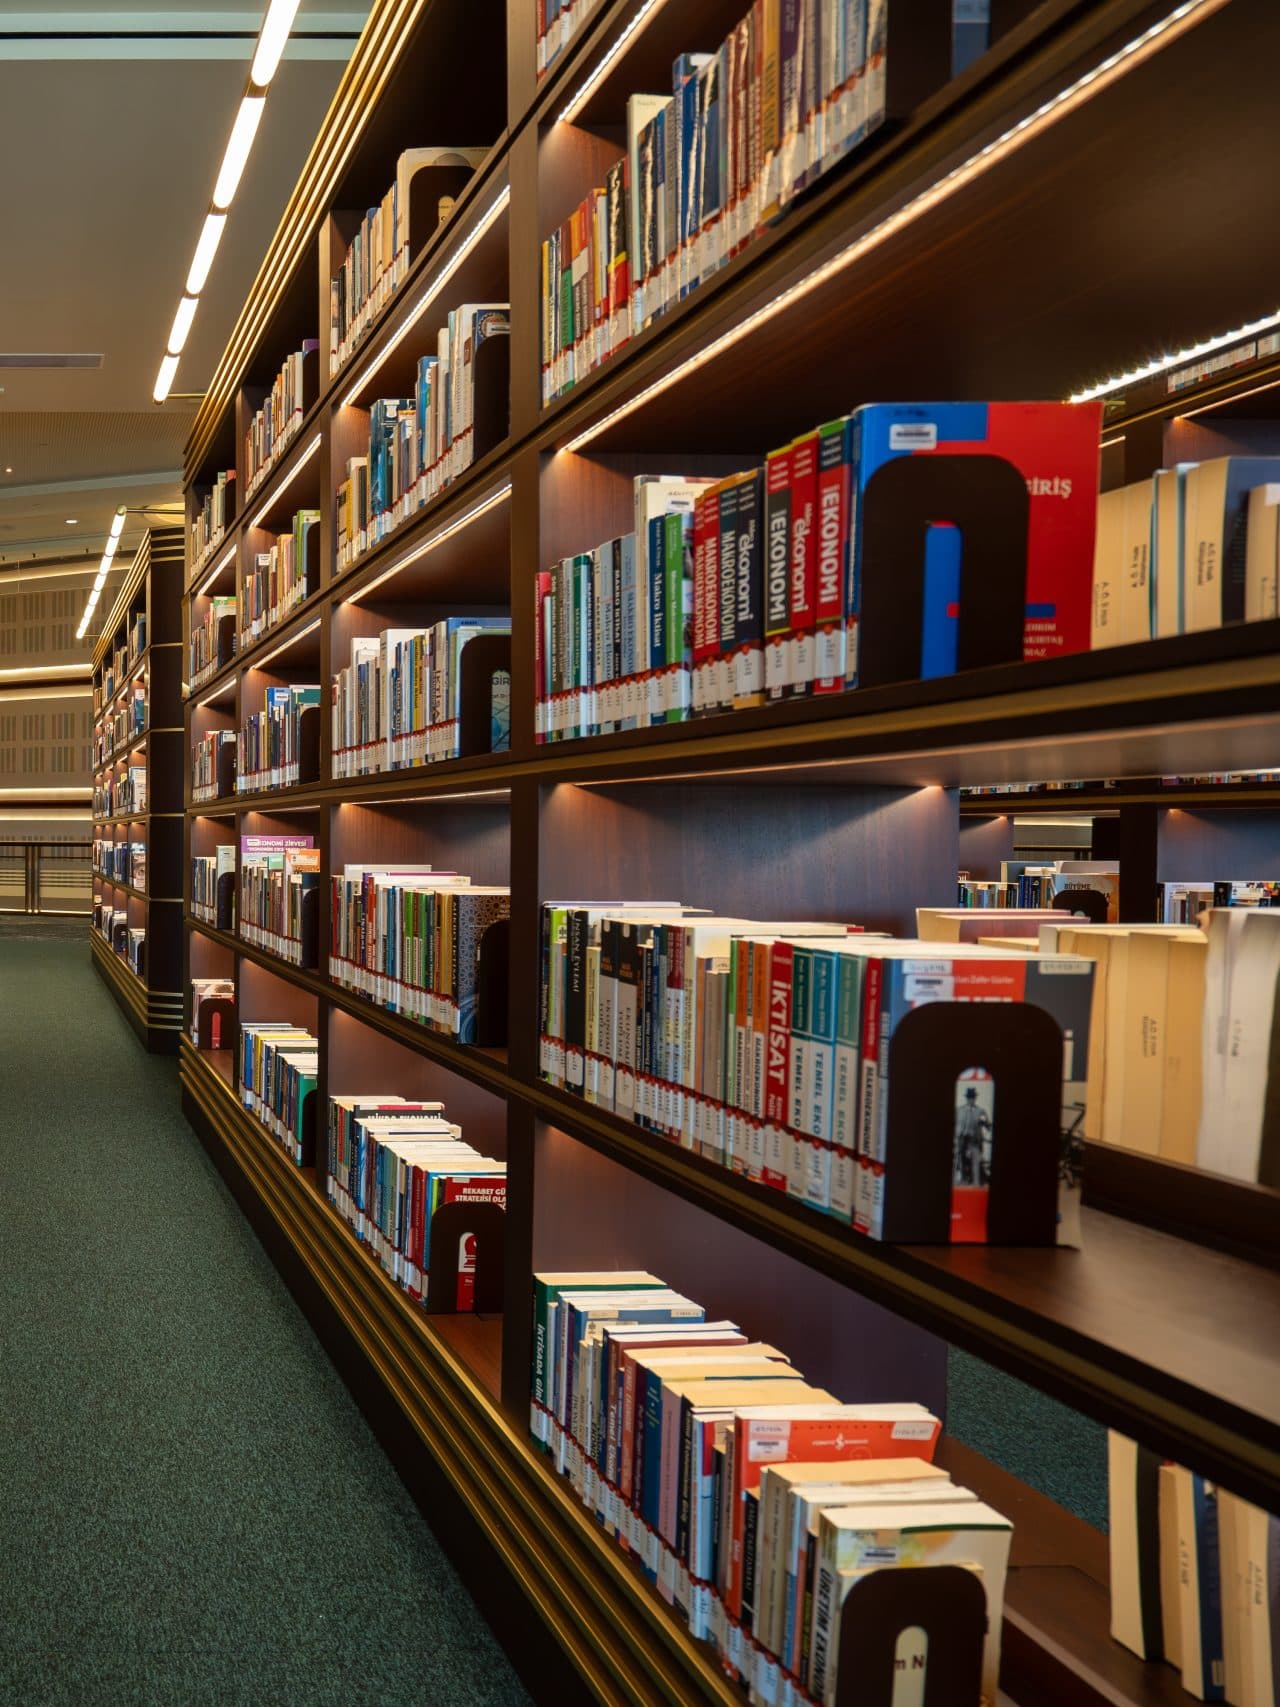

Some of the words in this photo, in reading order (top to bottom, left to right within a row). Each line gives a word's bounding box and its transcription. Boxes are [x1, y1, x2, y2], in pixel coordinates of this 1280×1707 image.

[737, 533, 755, 622] ekonomi
[792, 517, 810, 614] ekonomi
[770, 979, 792, 1086] İKTİSAT
[795, 1046, 803, 1092] TEMEL
[814, 1051, 824, 1098] TEMEL
[839, 1055, 849, 1105] TEMEL
[462, 1187, 494, 1195] REKABET
